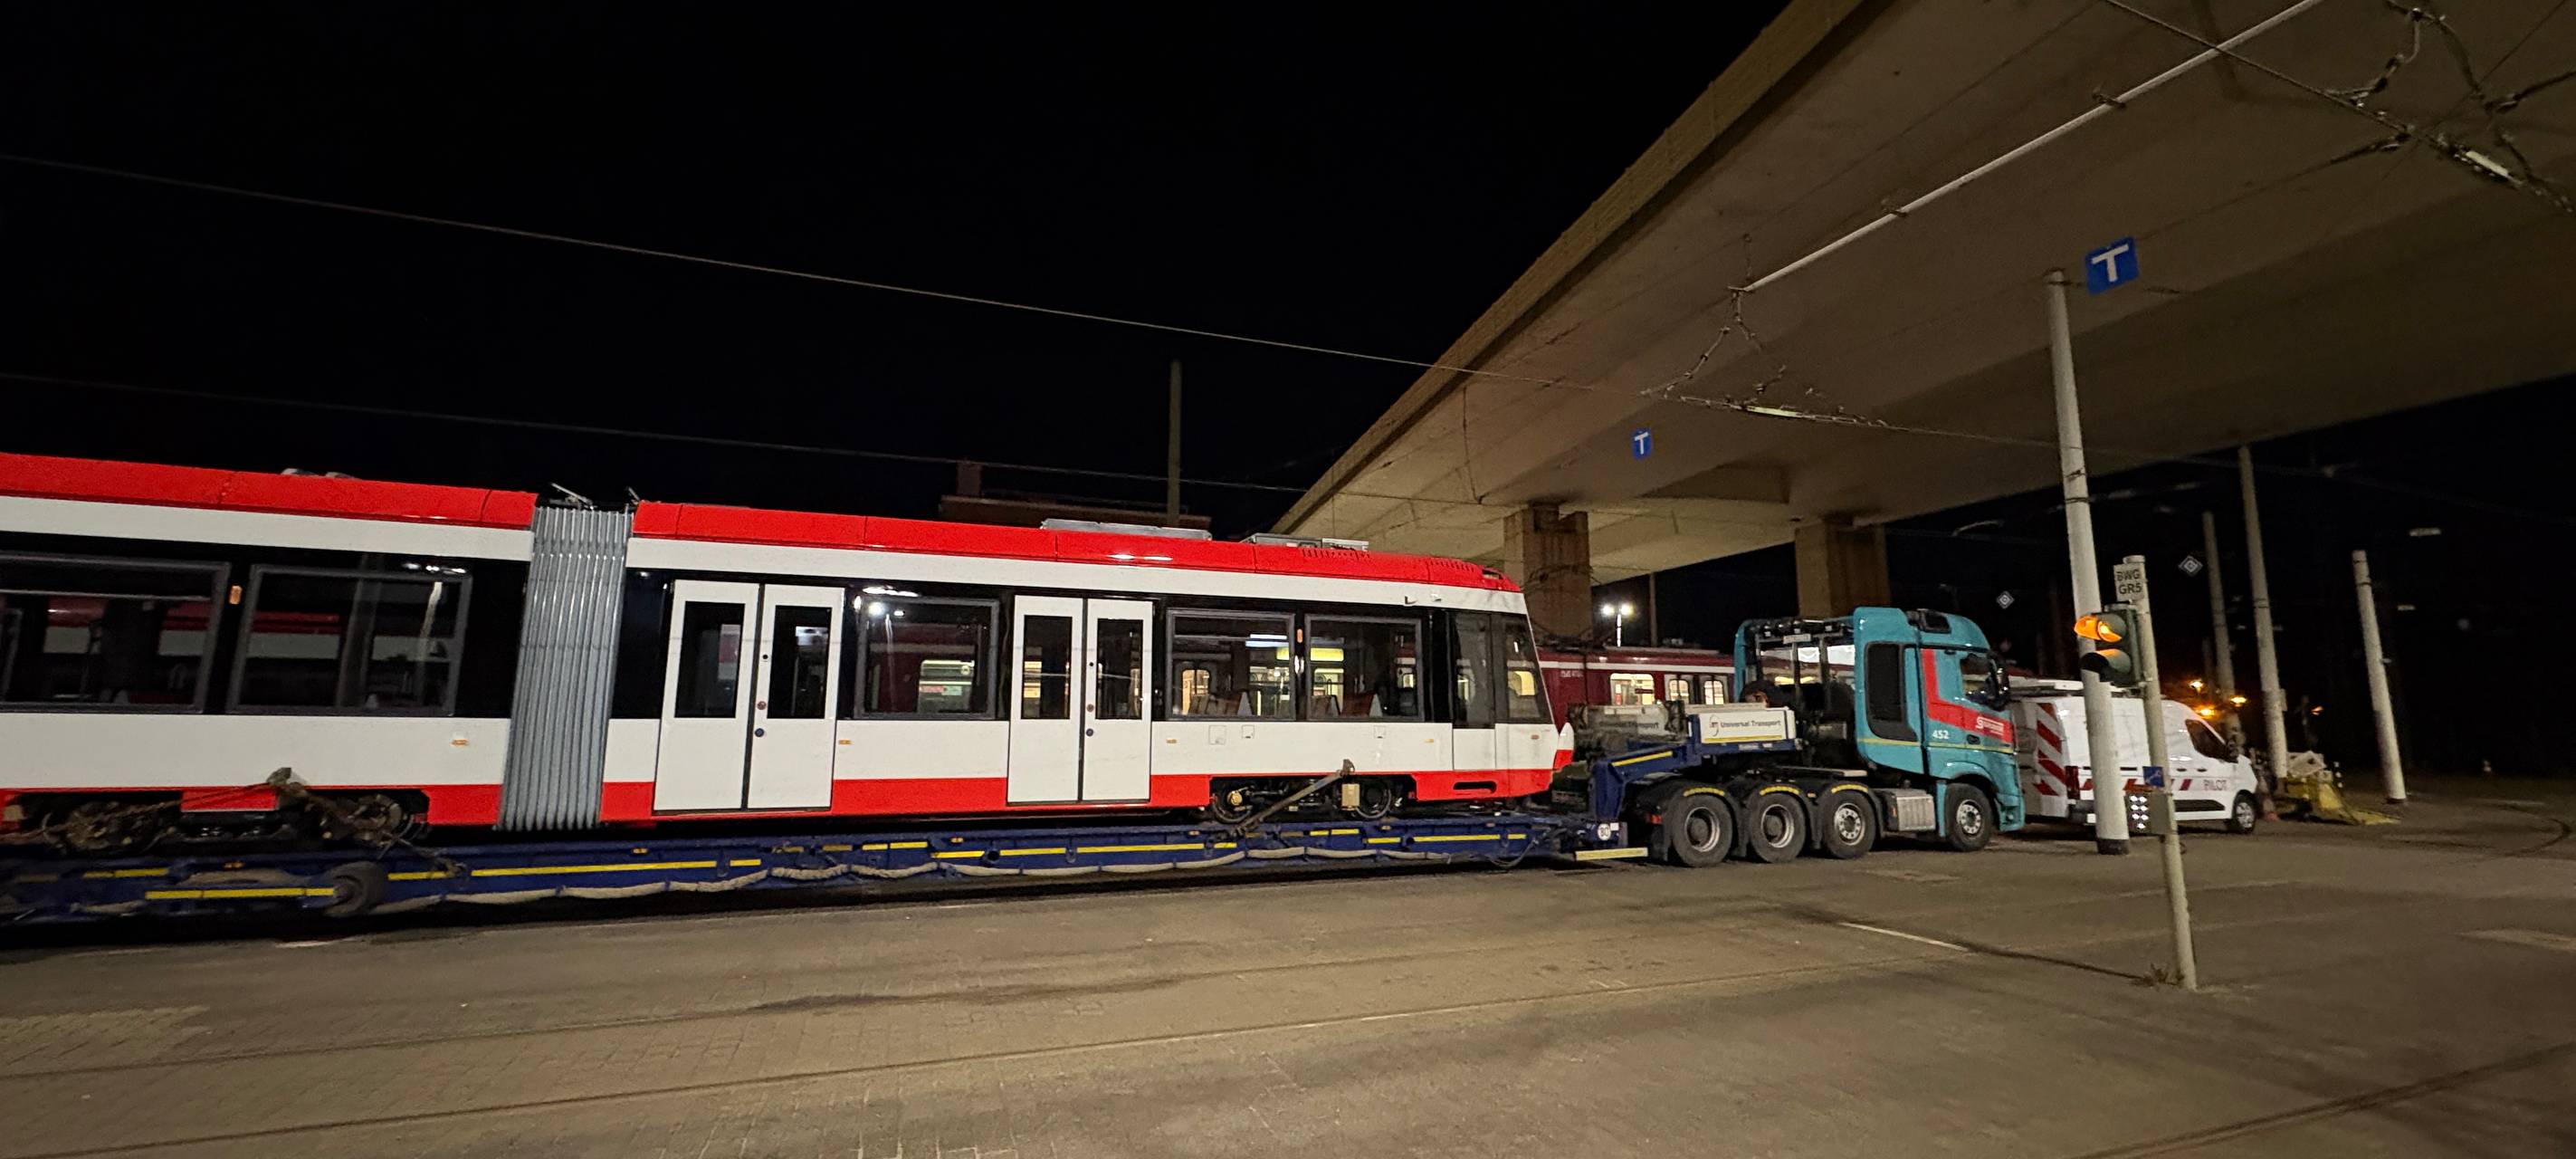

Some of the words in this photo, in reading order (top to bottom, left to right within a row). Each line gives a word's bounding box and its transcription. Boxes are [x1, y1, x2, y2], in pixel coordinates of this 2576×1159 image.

[2092, 244, 2130, 282] T
[1634, 431, 1649, 455] T
[2119, 582, 2143, 595] GR5
[1932, 730, 1950, 740] 452
